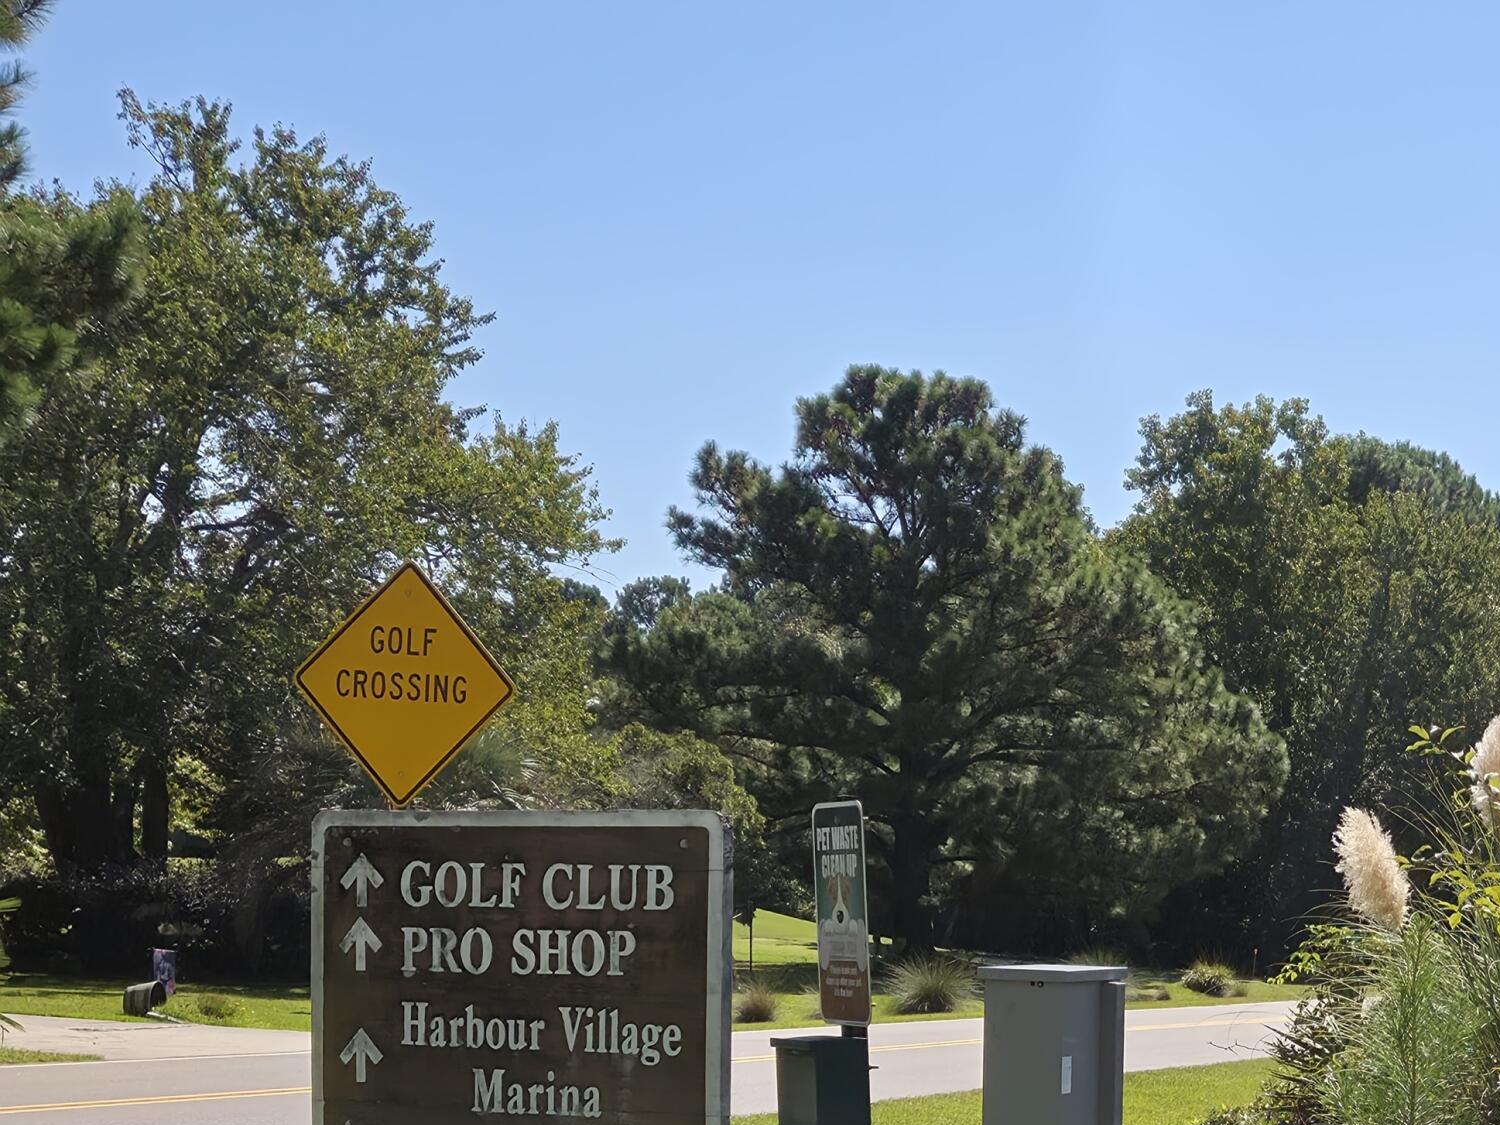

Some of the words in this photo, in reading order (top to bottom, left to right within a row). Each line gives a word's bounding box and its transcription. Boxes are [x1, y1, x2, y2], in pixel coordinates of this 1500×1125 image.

[369, 626, 438, 658] GOLF
[336, 669, 468, 705] CROSSING
[816, 827, 830, 851] PET
[831, 825, 859, 850] WASTE
[400, 860, 527, 910] GOLF
[542, 863, 675, 912] CLUB
[821, 854, 846, 879] CLEAN
[846, 853, 857, 878] UP
[401, 926, 493, 976] PRO
[511, 928, 637, 977] SHOP
[401, 1001, 545, 1052] Harbour
[558, 1006, 683, 1066] Village
[472, 1068, 602, 1119] Marina
